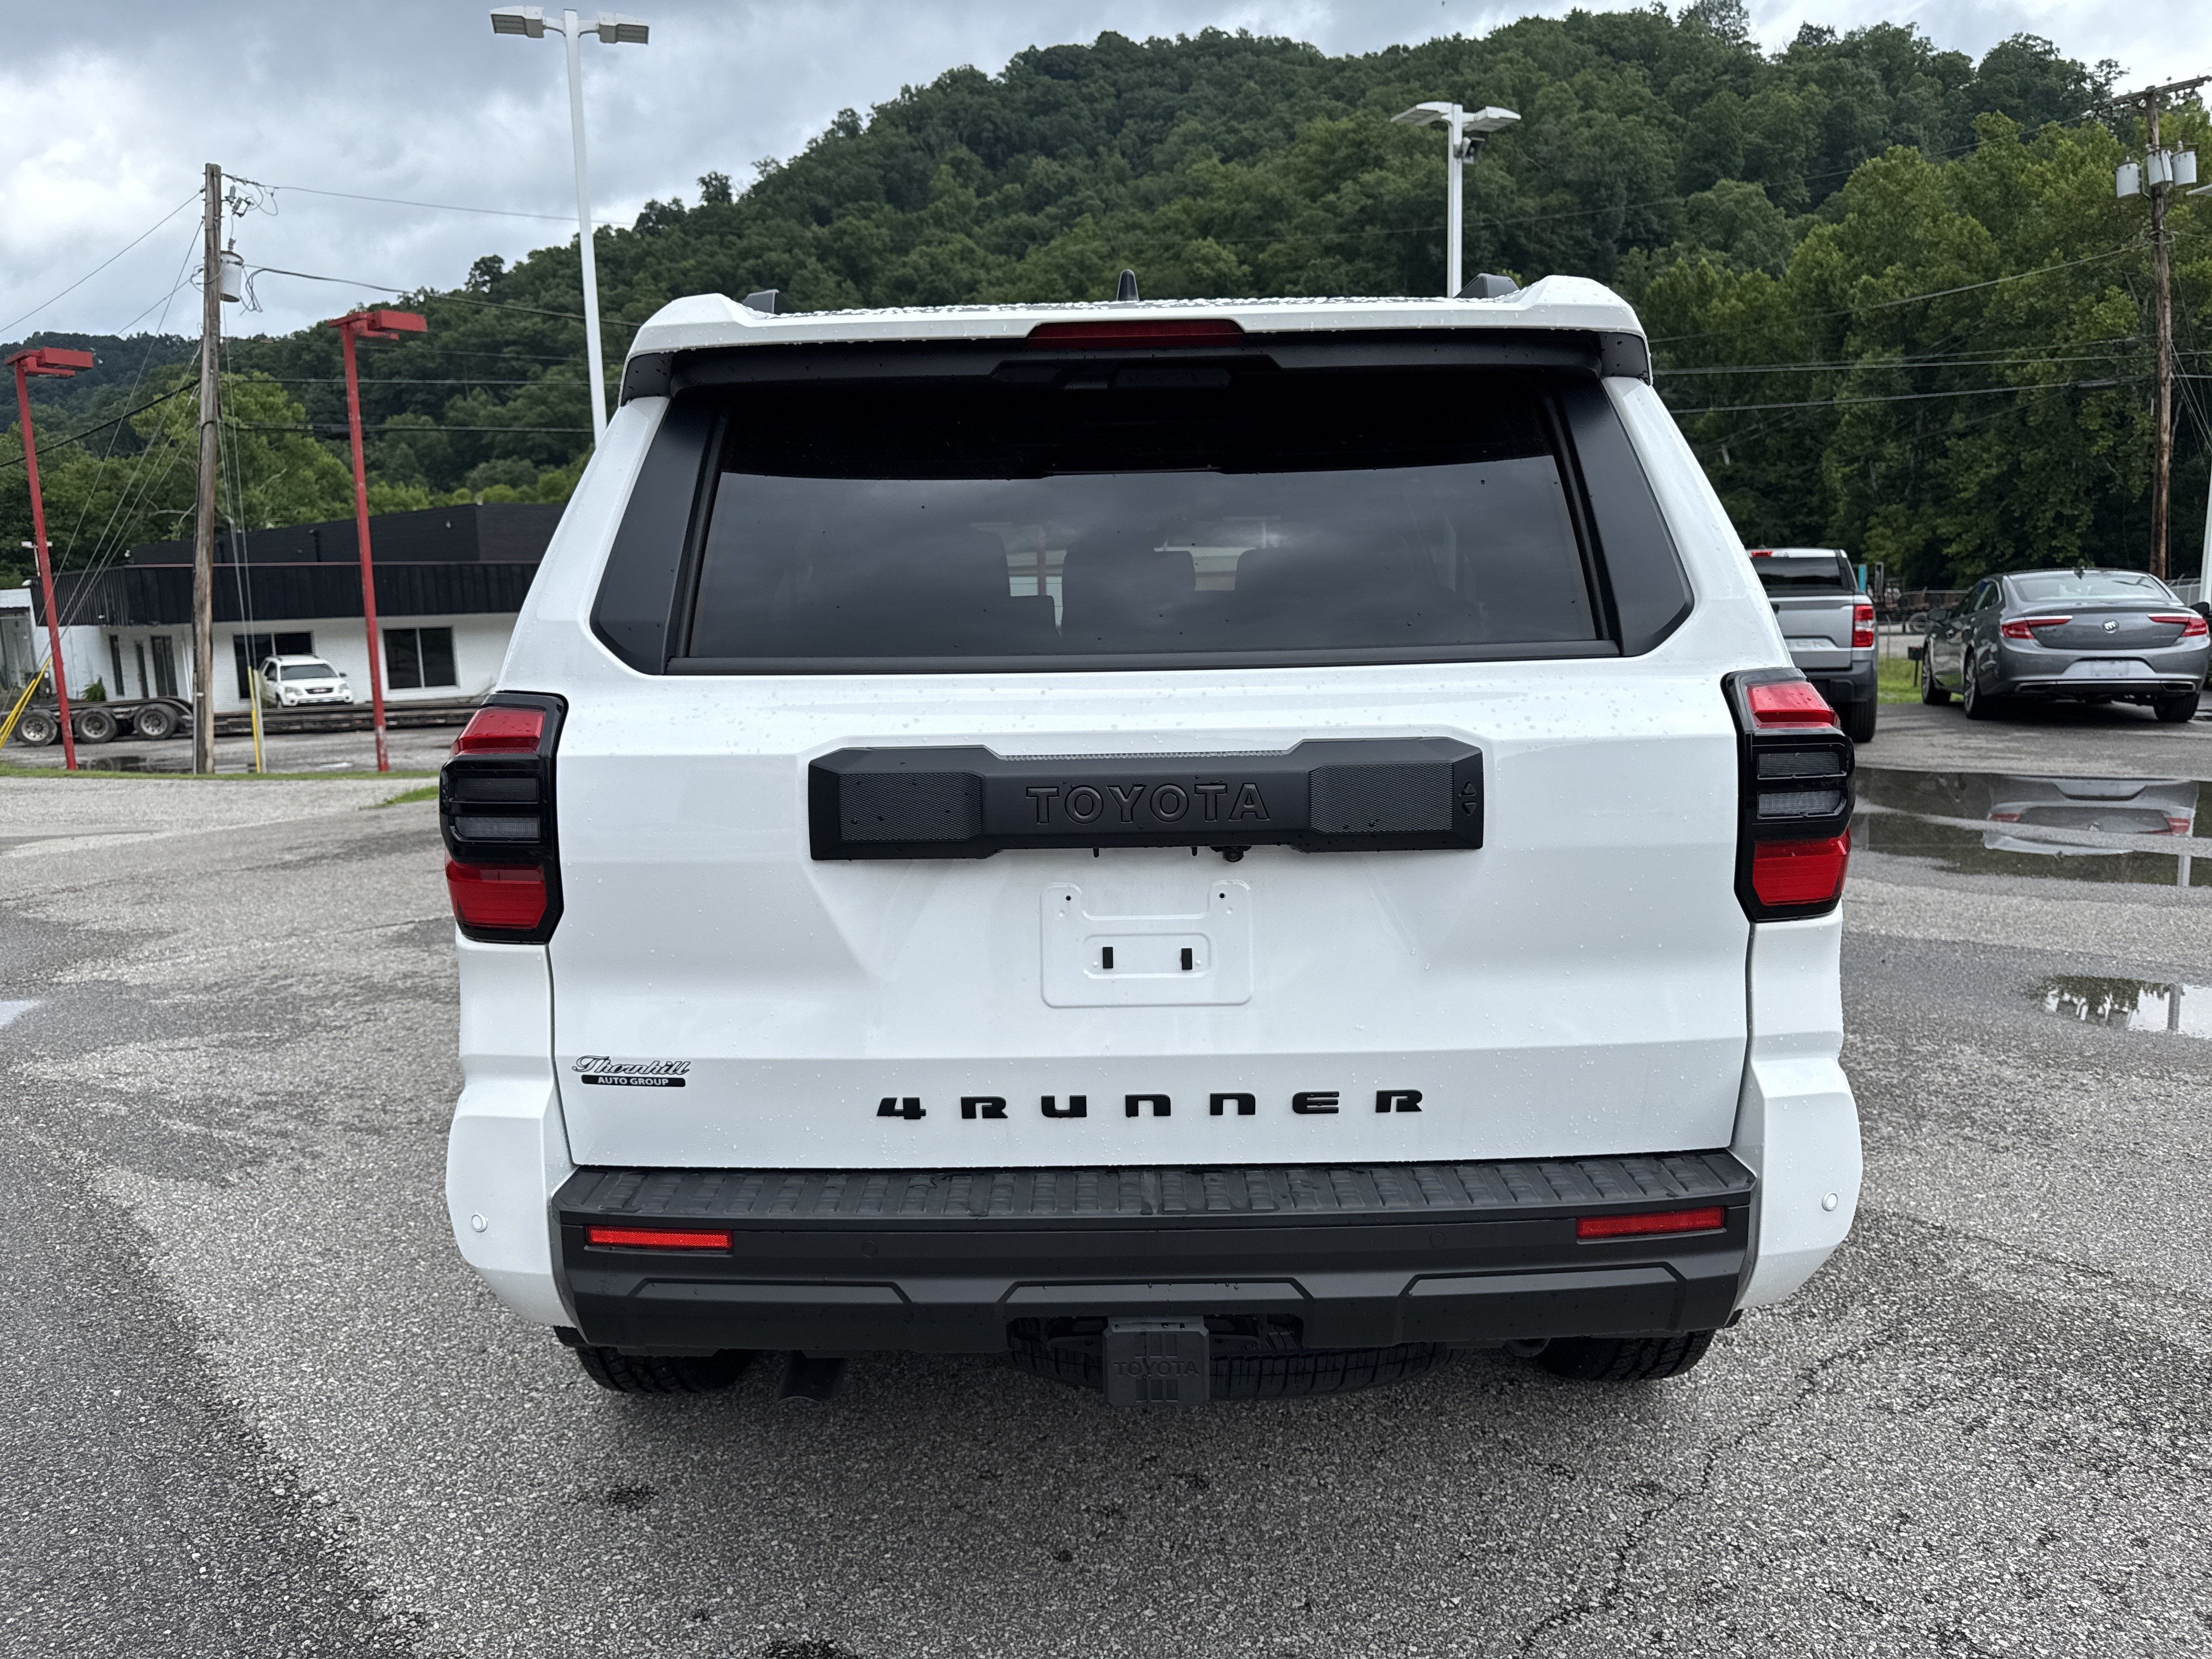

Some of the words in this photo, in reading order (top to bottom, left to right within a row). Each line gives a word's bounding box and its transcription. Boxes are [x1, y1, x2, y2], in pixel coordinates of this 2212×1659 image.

[1026, 782, 1271, 825] TOYOTA
[572, 1055, 691, 1075] Thornhill
[597, 1076, 628, 1085] AUTO
[630, 1077, 669, 1086] GROUP
[877, 1089, 1424, 1120] 4RUNNER
[1113, 1361, 1200, 1377] TOYOTA
